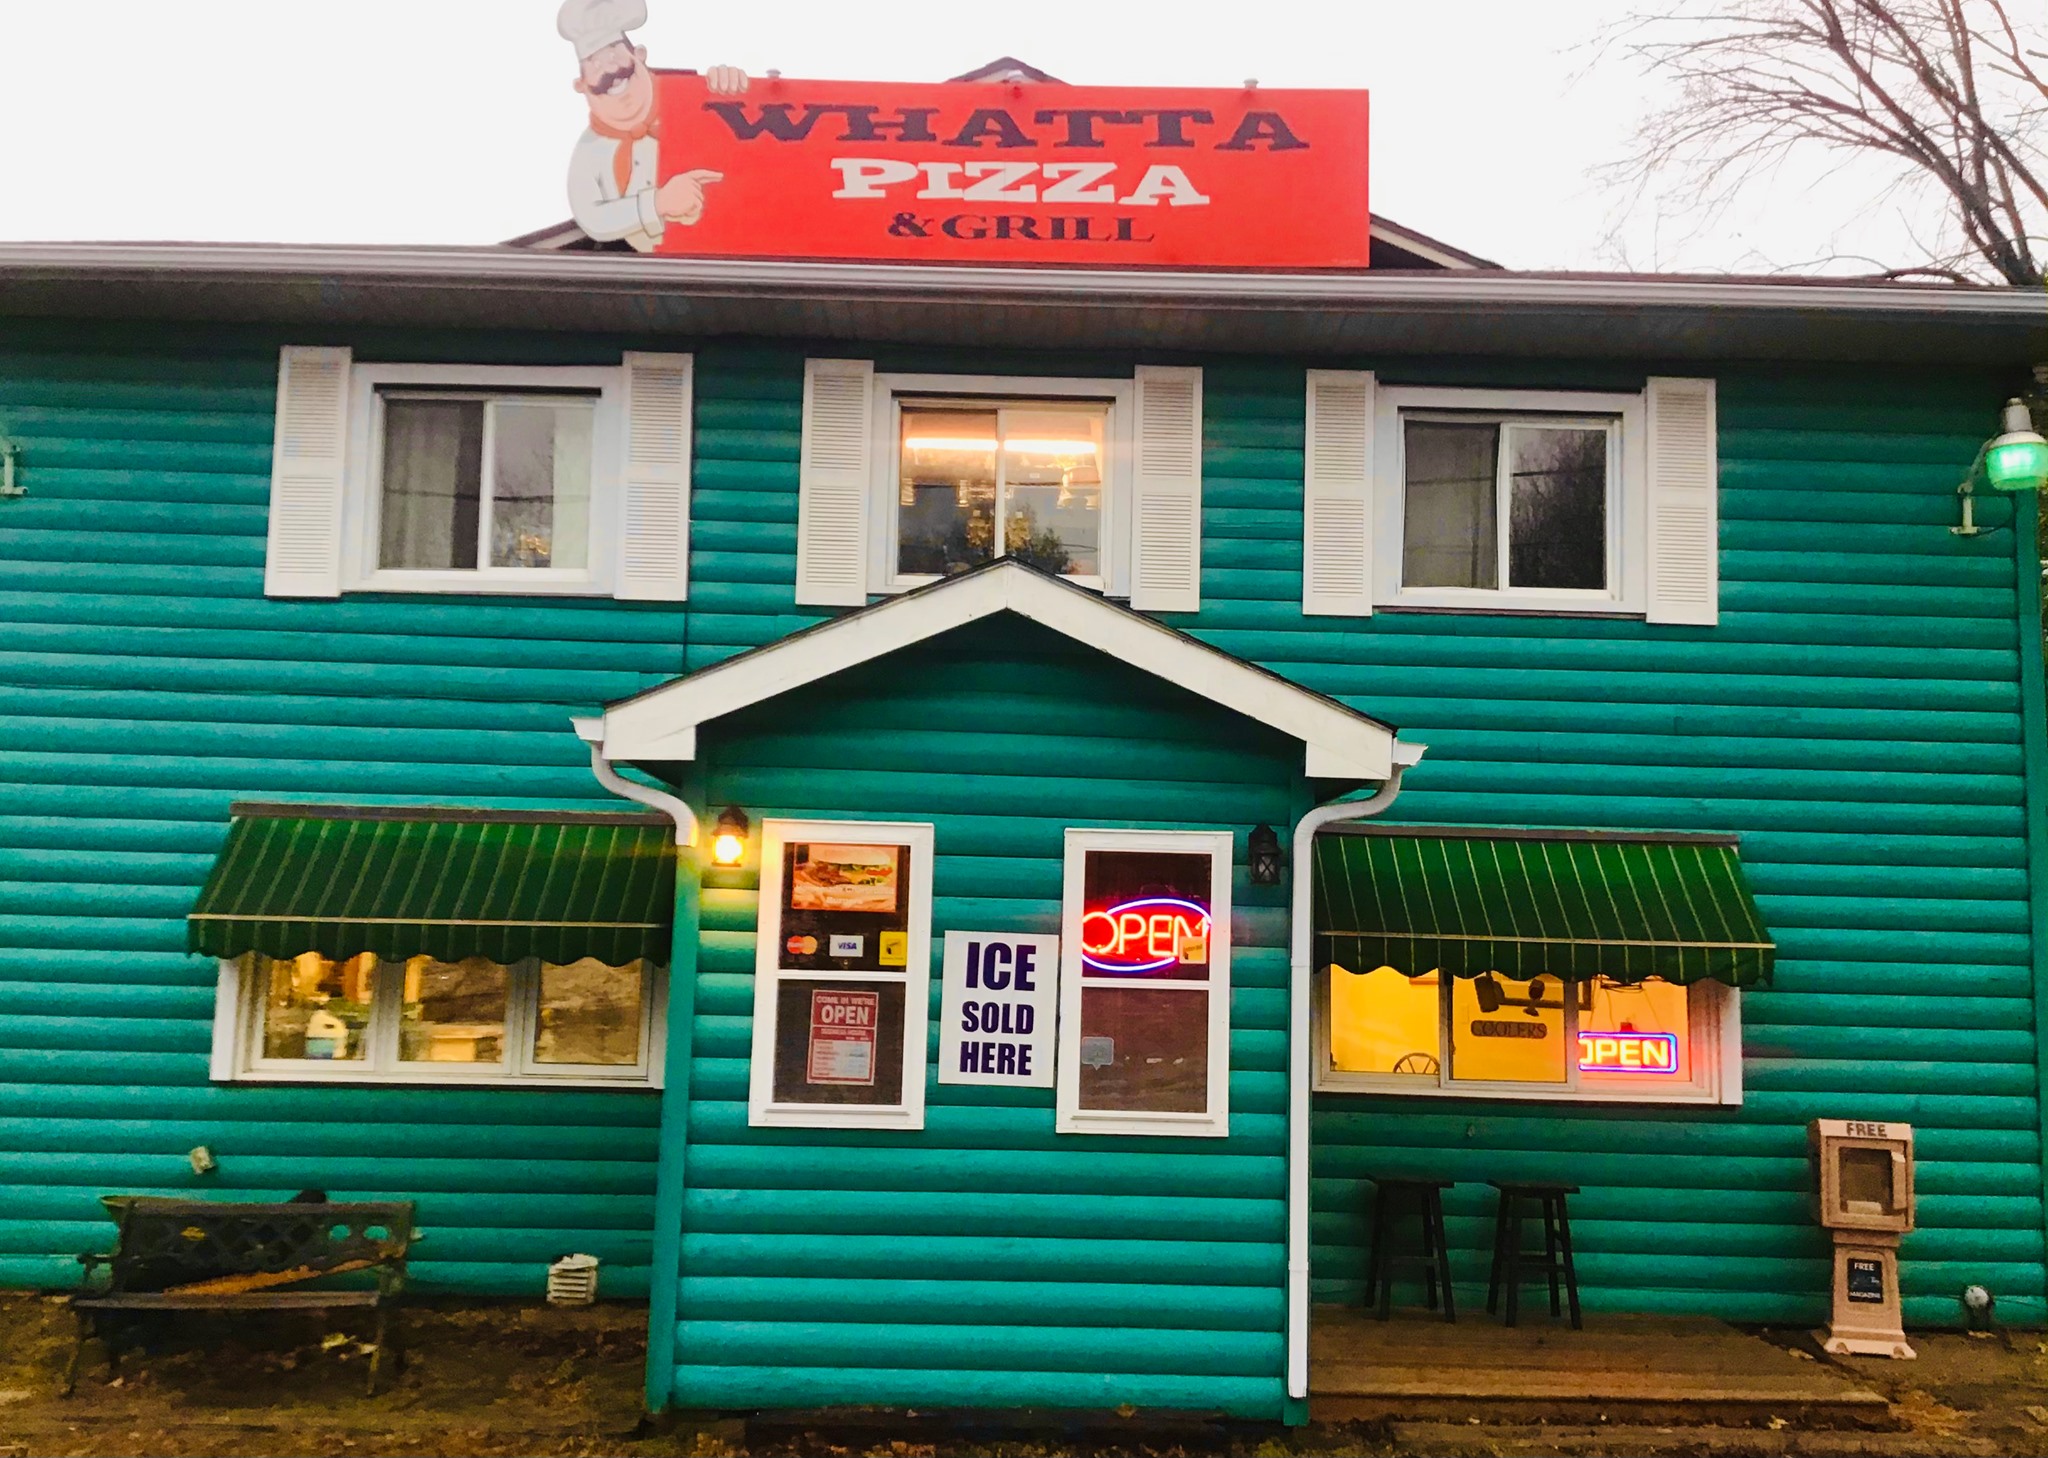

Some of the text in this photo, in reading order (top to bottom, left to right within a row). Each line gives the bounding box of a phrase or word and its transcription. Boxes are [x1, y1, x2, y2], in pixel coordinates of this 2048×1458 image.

[702, 101, 1310, 151] WHATTA
[830, 158, 1210, 206] PIZZA
[837, 942, 857, 950] VISA
[1082, 911, 1209, 956] OPEN
[966, 942, 1036, 991] ICE
[815, 995, 839, 1004] COME
[821, 1004, 869, 1025] OPEN
[961, 1001, 1034, 1034] SOLD
[1471, 1021, 1547, 1038] COOLERS
[959, 1041, 1033, 1076] HERE
[1846, 1122, 1887, 1137] FREE
[1854, 1262, 1875, 1271] FREE
